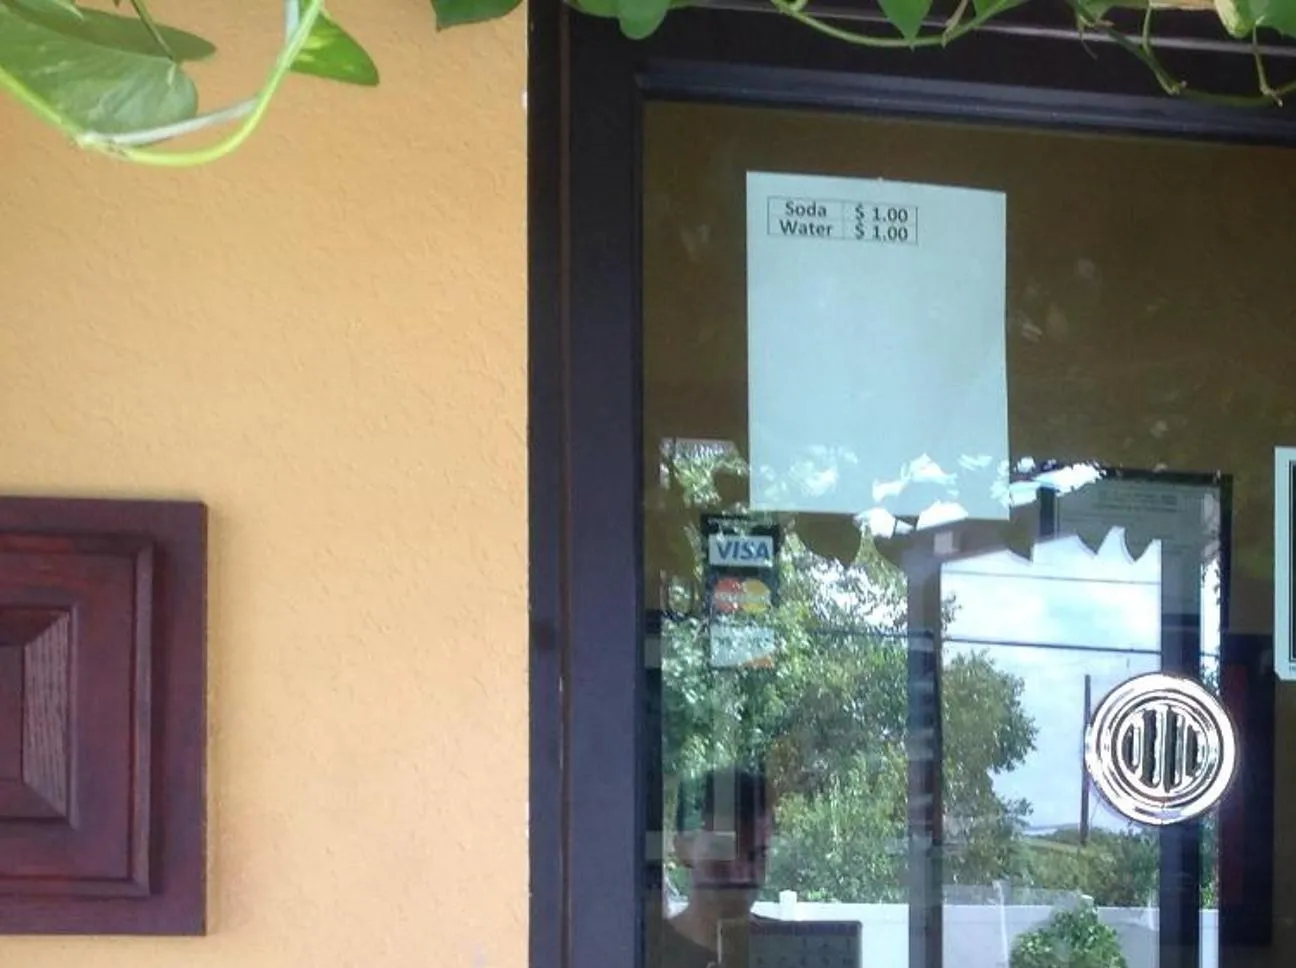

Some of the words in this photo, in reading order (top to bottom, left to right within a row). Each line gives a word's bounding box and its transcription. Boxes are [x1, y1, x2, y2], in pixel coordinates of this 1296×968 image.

[785, 201, 827, 217] Soda
[873, 207, 908, 223] 1.00
[779, 219, 833, 236] Water
[873, 226, 908, 242] 1.00
[716, 541, 770, 561] VISA
